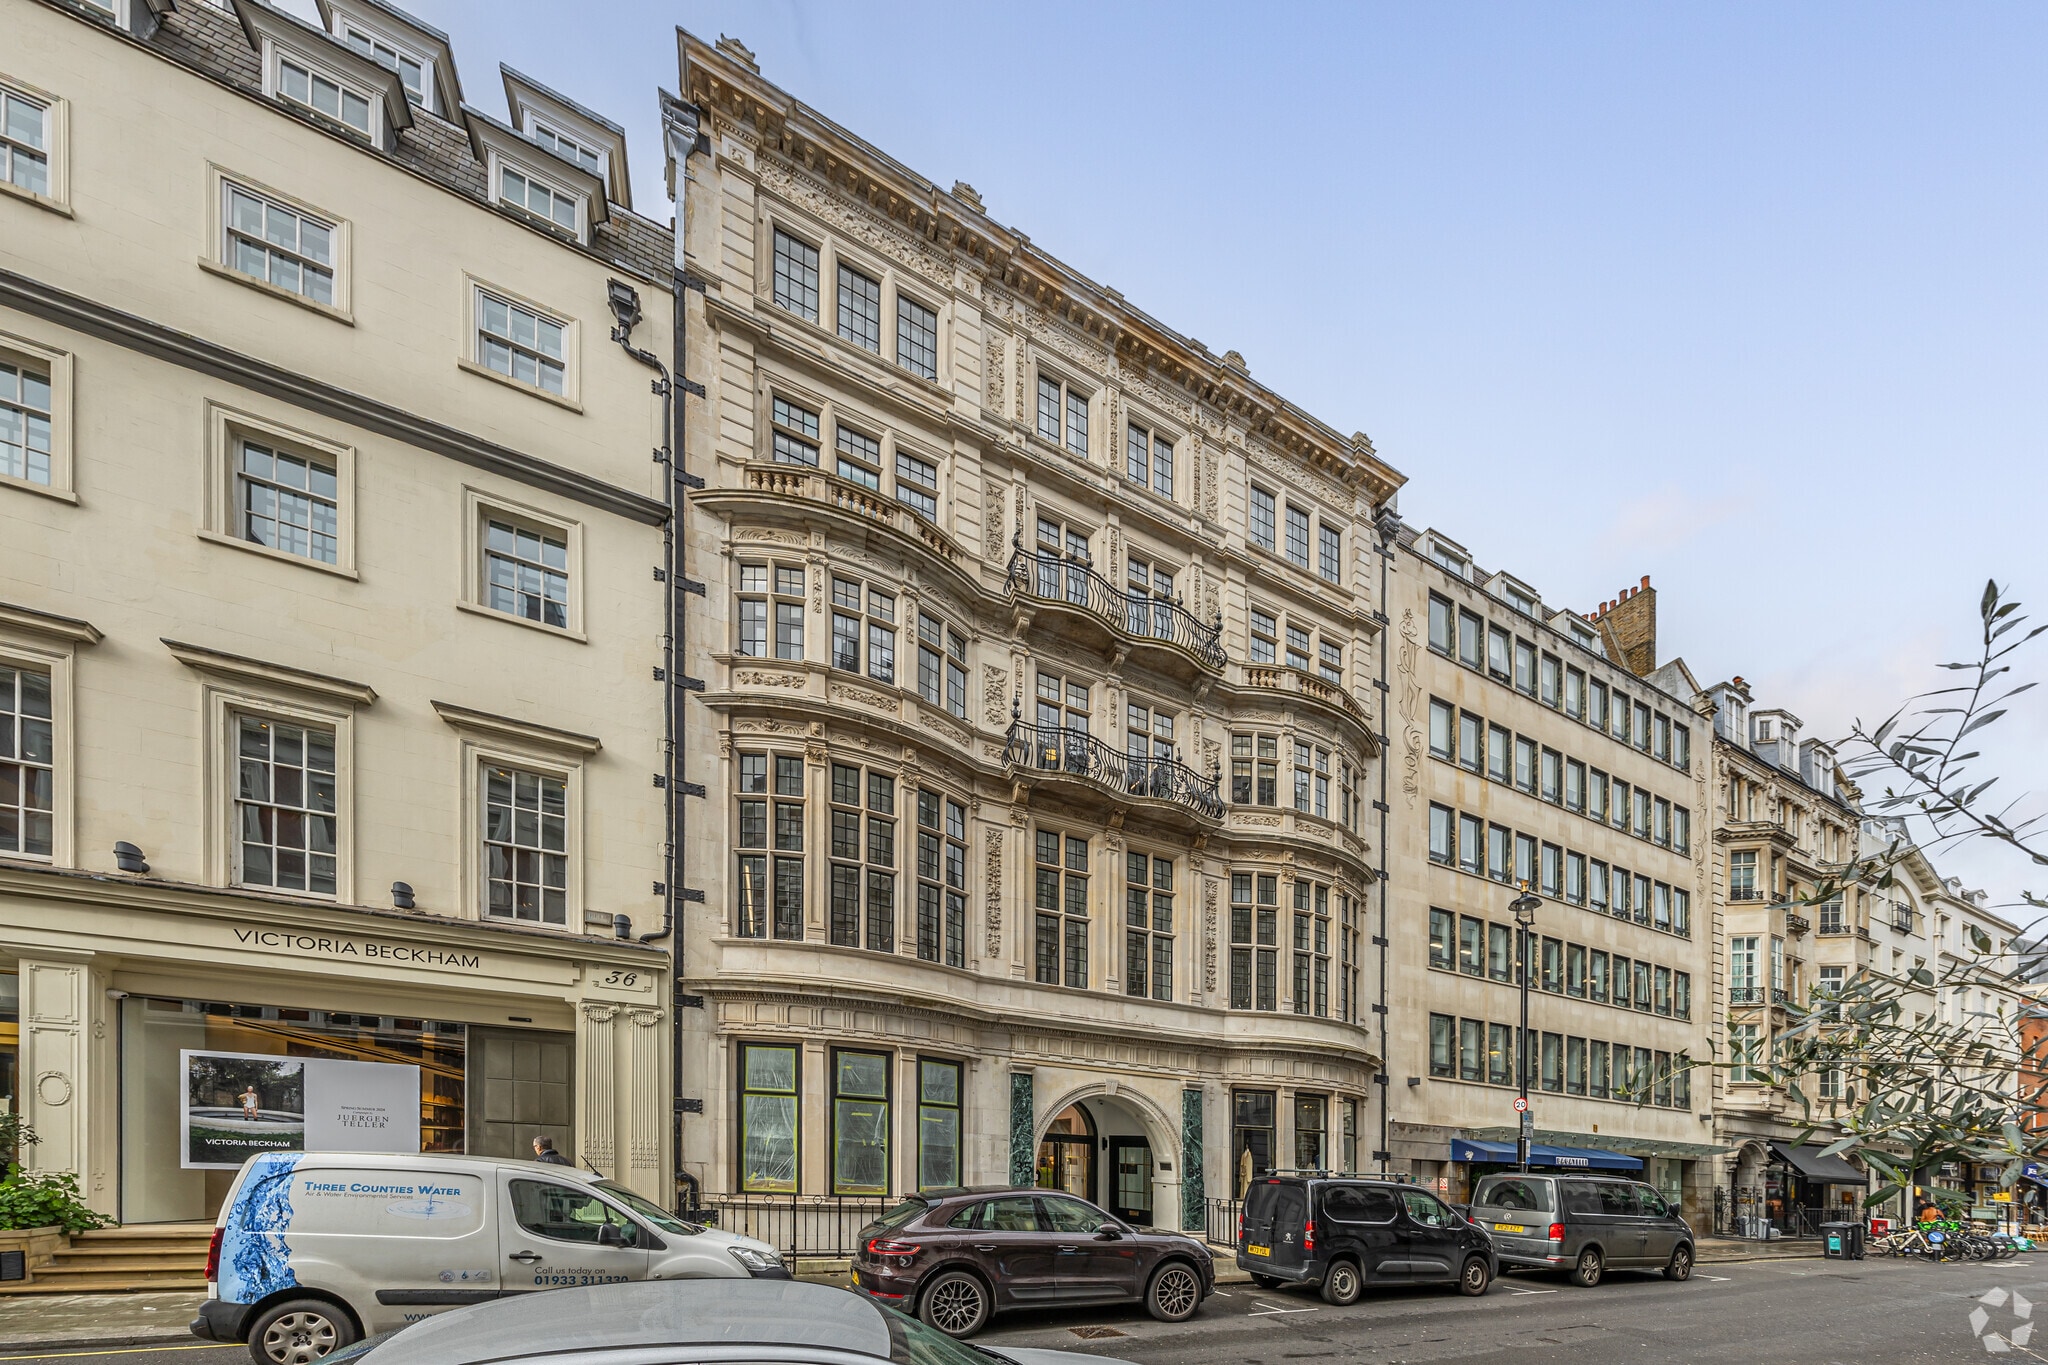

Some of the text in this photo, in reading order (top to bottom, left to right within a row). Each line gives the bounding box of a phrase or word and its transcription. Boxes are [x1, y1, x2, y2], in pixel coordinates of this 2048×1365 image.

[233, 928, 480, 969] VICTORIA BECKHAM
[605, 970, 637, 987] 36
[337, 1114, 389, 1122] JUERGEN
[1015, 1161, 1032, 1173] 35
[305, 1181, 461, 1196] THREE COUNTIES WATER
[568, 1267, 592, 1275] today
[534, 1276, 576, 1285] 01933
